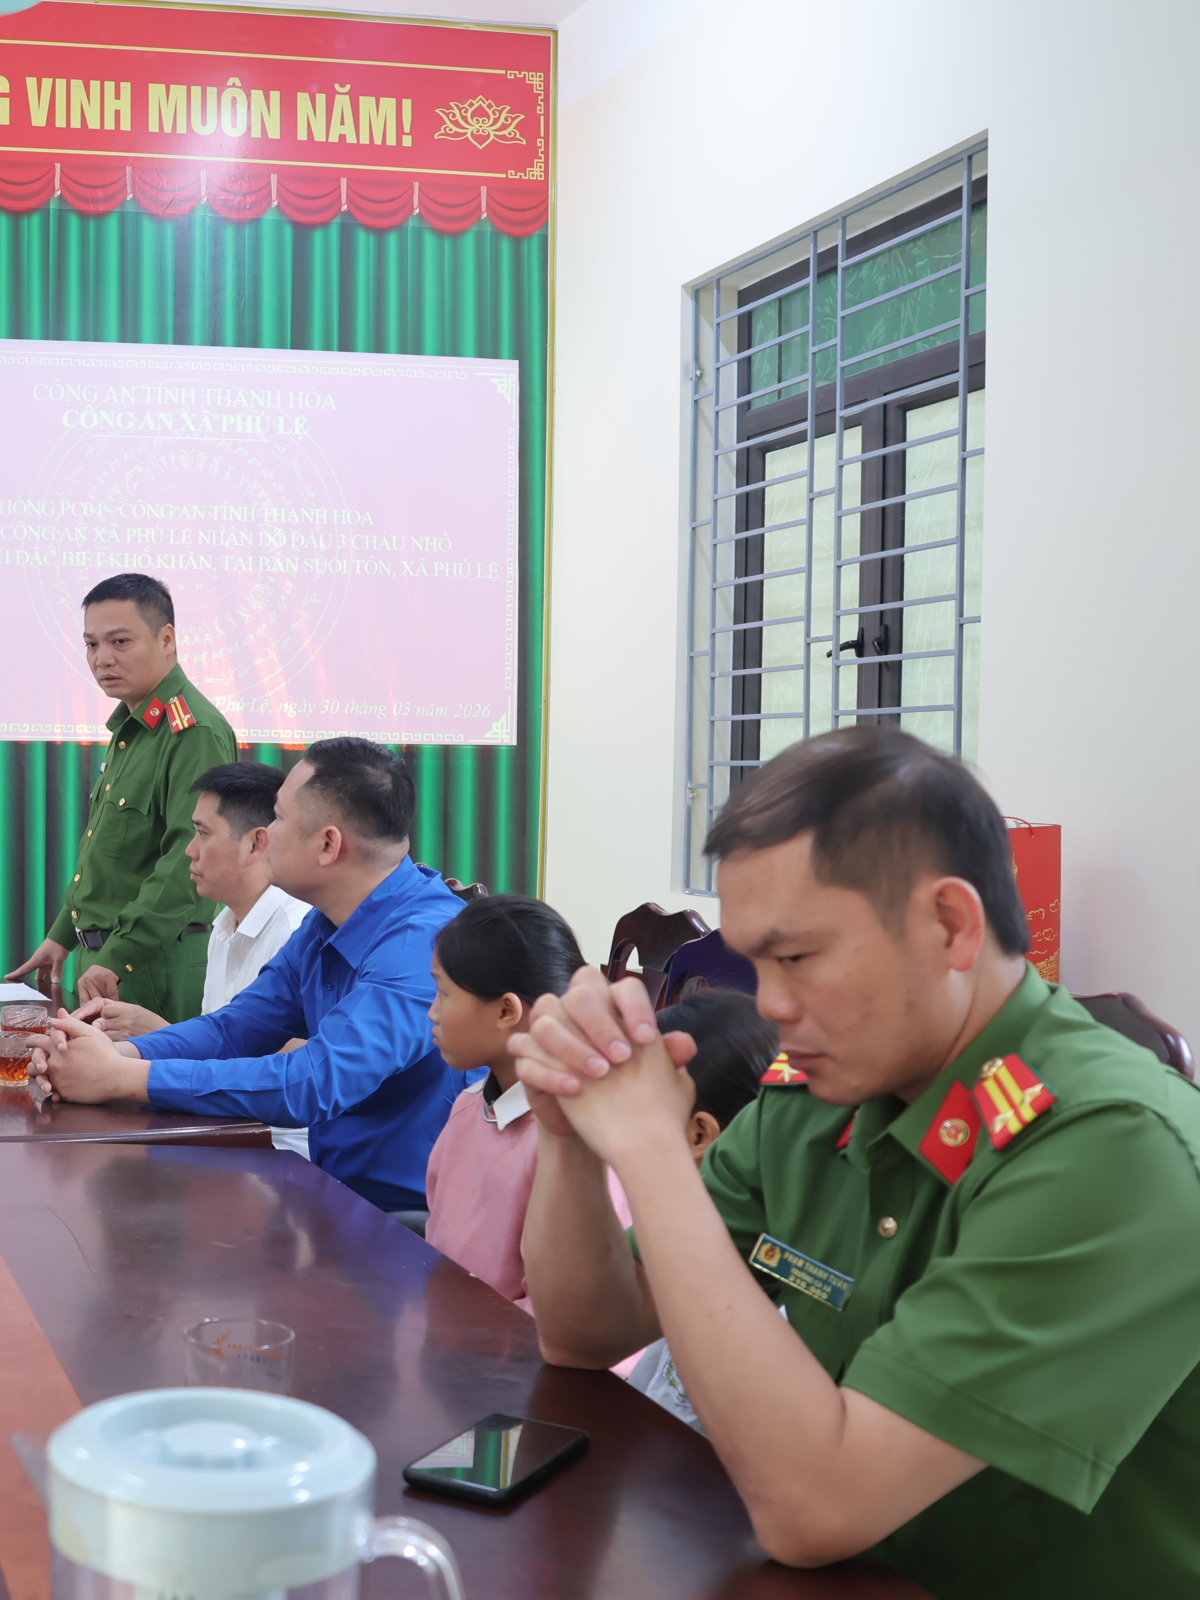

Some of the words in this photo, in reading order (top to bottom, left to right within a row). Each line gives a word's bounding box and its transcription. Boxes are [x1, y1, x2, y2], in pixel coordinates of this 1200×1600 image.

[25, 76, 132, 131] VINH
[148, 76, 281, 140] MUÔN
[296, 83, 413, 148] NĂM!
[33, 378, 98, 402] CÔNG
[103, 385, 136, 404] AN
[202, 386, 282, 408] THANH
[288, 386, 337, 410] HÓA
[62, 405, 135, 430] CÔNG
[140, 411, 173, 431] AN
[180, 410, 214, 432] XÃ
[221, 410, 271, 434] PHÚ
[277, 414, 309, 440] LỆ
[119, 498, 174, 519] CÔNG
[179, 504, 206, 521] AN
[260, 506, 328, 524] THANH
[332, 505, 375, 526] HÓA
[0, 521, 57, 541] CÔNG
[60, 526, 88, 542] AN
[92, 523, 120, 543] XÃ
[126, 524, 164, 544] PHÚ
[169, 527, 193, 548] LỆ
[337, 533, 346, 549] 3
[351, 531, 406, 551] CHÁU
[410, 532, 452, 553] NHỎ
[62, 550, 105, 571] BIỆT
[353, 556, 396, 578] TÔN,
[400, 557, 429, 577] XÃ
[433, 558, 472, 578] PHÚ
[476, 561, 500, 582] LỆ
[278, 699, 315, 718] ngày
[320, 699, 340, 715] 30
[344, 699, 387, 719] tháng
[392, 701, 411, 716] 03
[415, 702, 448, 717] năm
[453, 702, 491, 718] 2026
